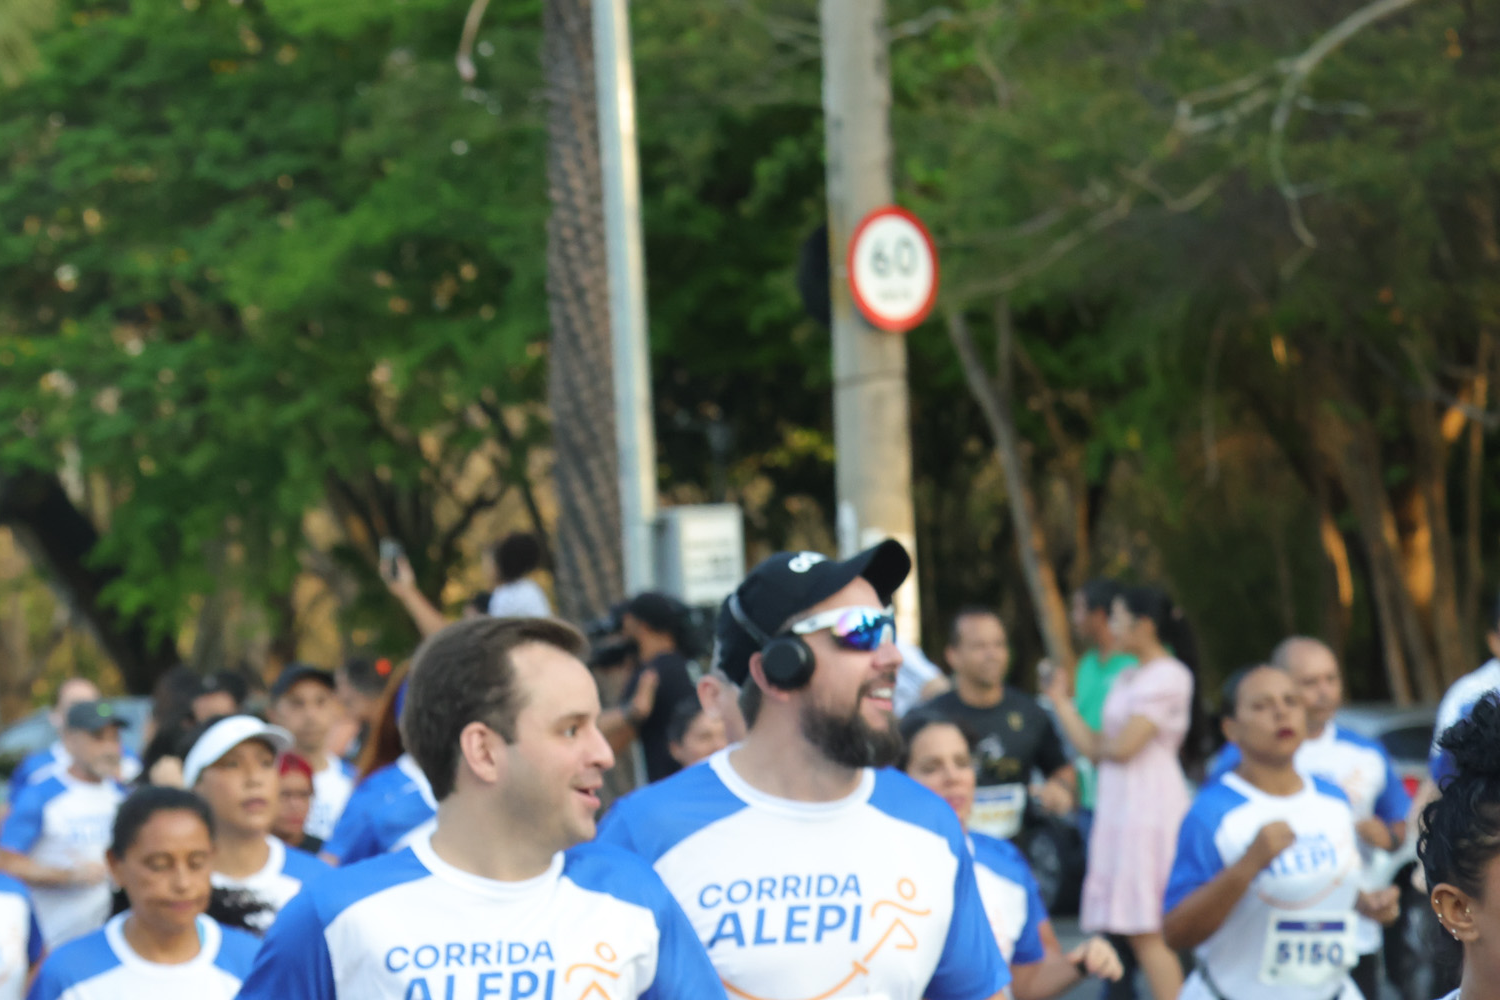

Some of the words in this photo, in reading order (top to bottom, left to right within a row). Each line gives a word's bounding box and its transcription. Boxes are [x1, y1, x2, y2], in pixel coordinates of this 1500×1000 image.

[869, 234, 918, 278] 60
[697, 873, 862, 909] CORRIDA
[706, 904, 863, 950] ALEPI
[385, 940, 556, 974] CORRIDA
